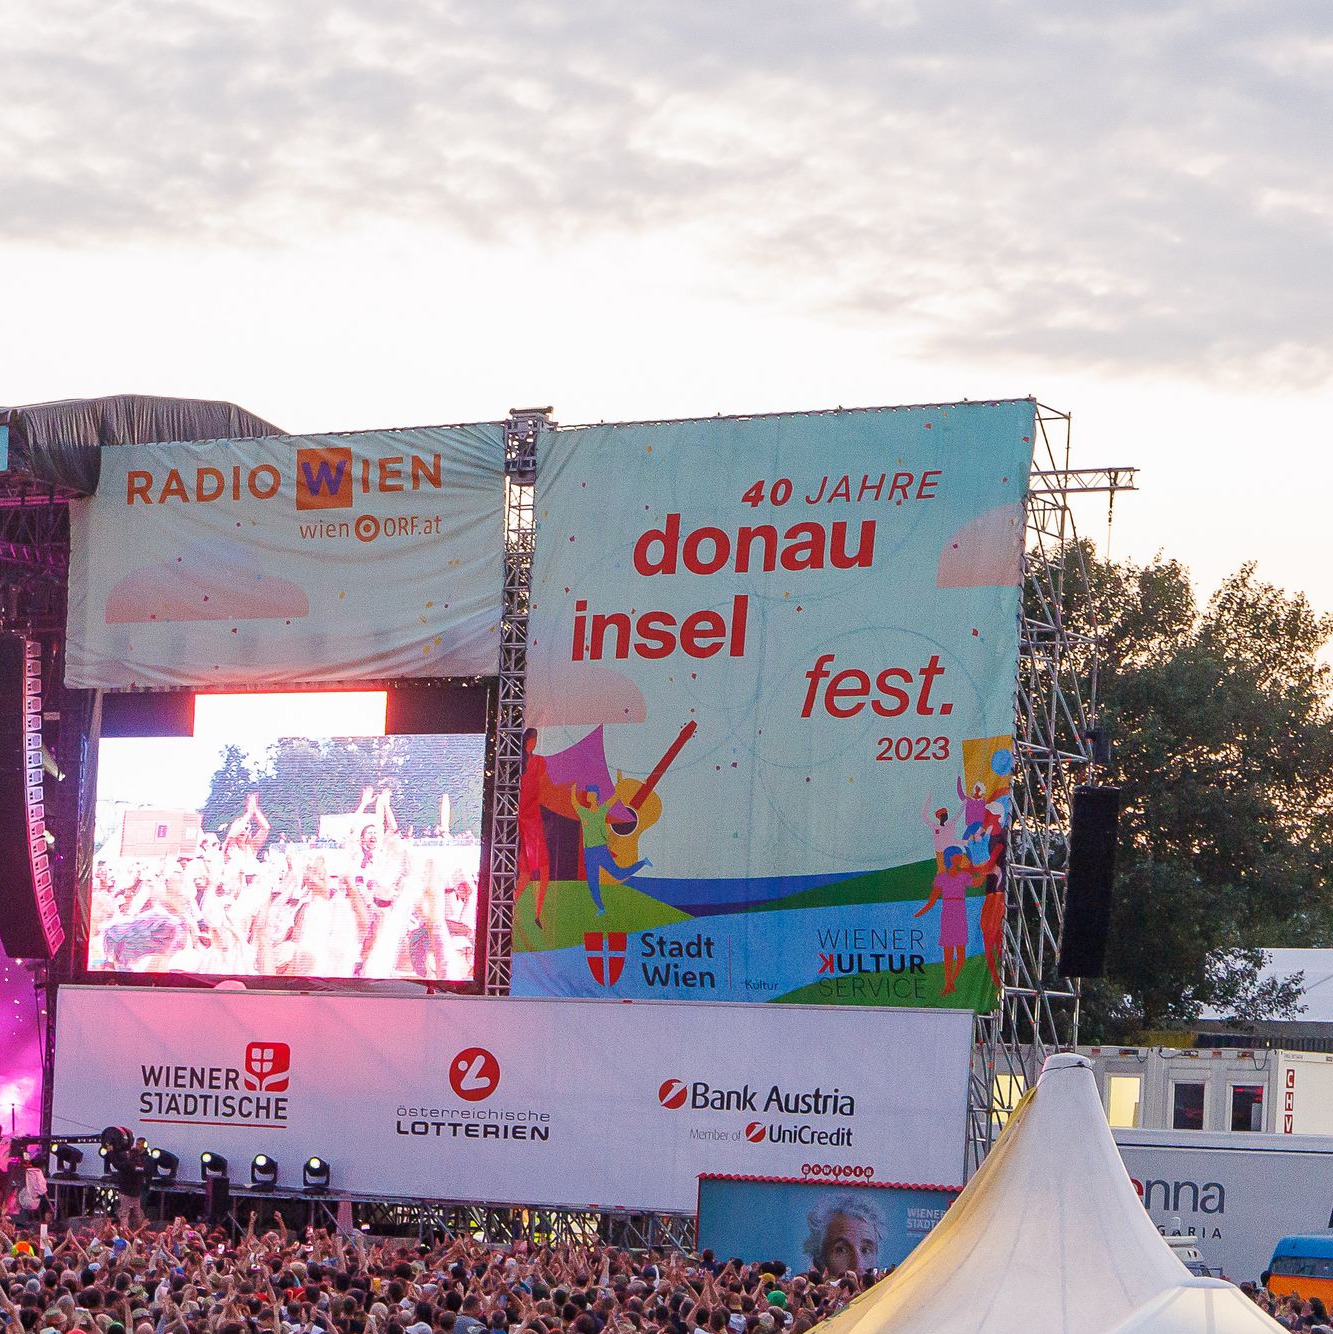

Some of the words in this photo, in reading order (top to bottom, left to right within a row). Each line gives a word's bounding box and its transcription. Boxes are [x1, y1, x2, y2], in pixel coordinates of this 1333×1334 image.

[126, 464, 281, 505] RADIO
[301, 454, 442, 498] WIEN
[741, 478, 792, 508] 40
[805, 470, 943, 506] JAHRE
[299, 518, 350, 540] wien
[633, 513, 877, 577] donau
[571, 594, 749, 662] insel
[800, 653, 954, 720] fest.
[876, 736, 950, 762] 2023
[640, 932, 716, 960] Stadt
[817, 928, 924, 951] WIENER
[641, 961, 716, 989] Wien
[745, 978, 780, 992] Kultur
[819, 976, 928, 1000] SERVICE
[141, 1064, 240, 1091] WIENER
[139, 1091, 288, 1120] STÄDTISCHE
[691, 1081, 758, 1113] Bank
[763, 1086, 855, 1116] Austria
[396, 1105, 550, 1122] österreichische
[396, 1120, 550, 1142] LOTTERIEN
[690, 1127, 729, 1142] Member
[732, 1128, 742, 1143] of
[769, 1124, 853, 1147] UniCredit
